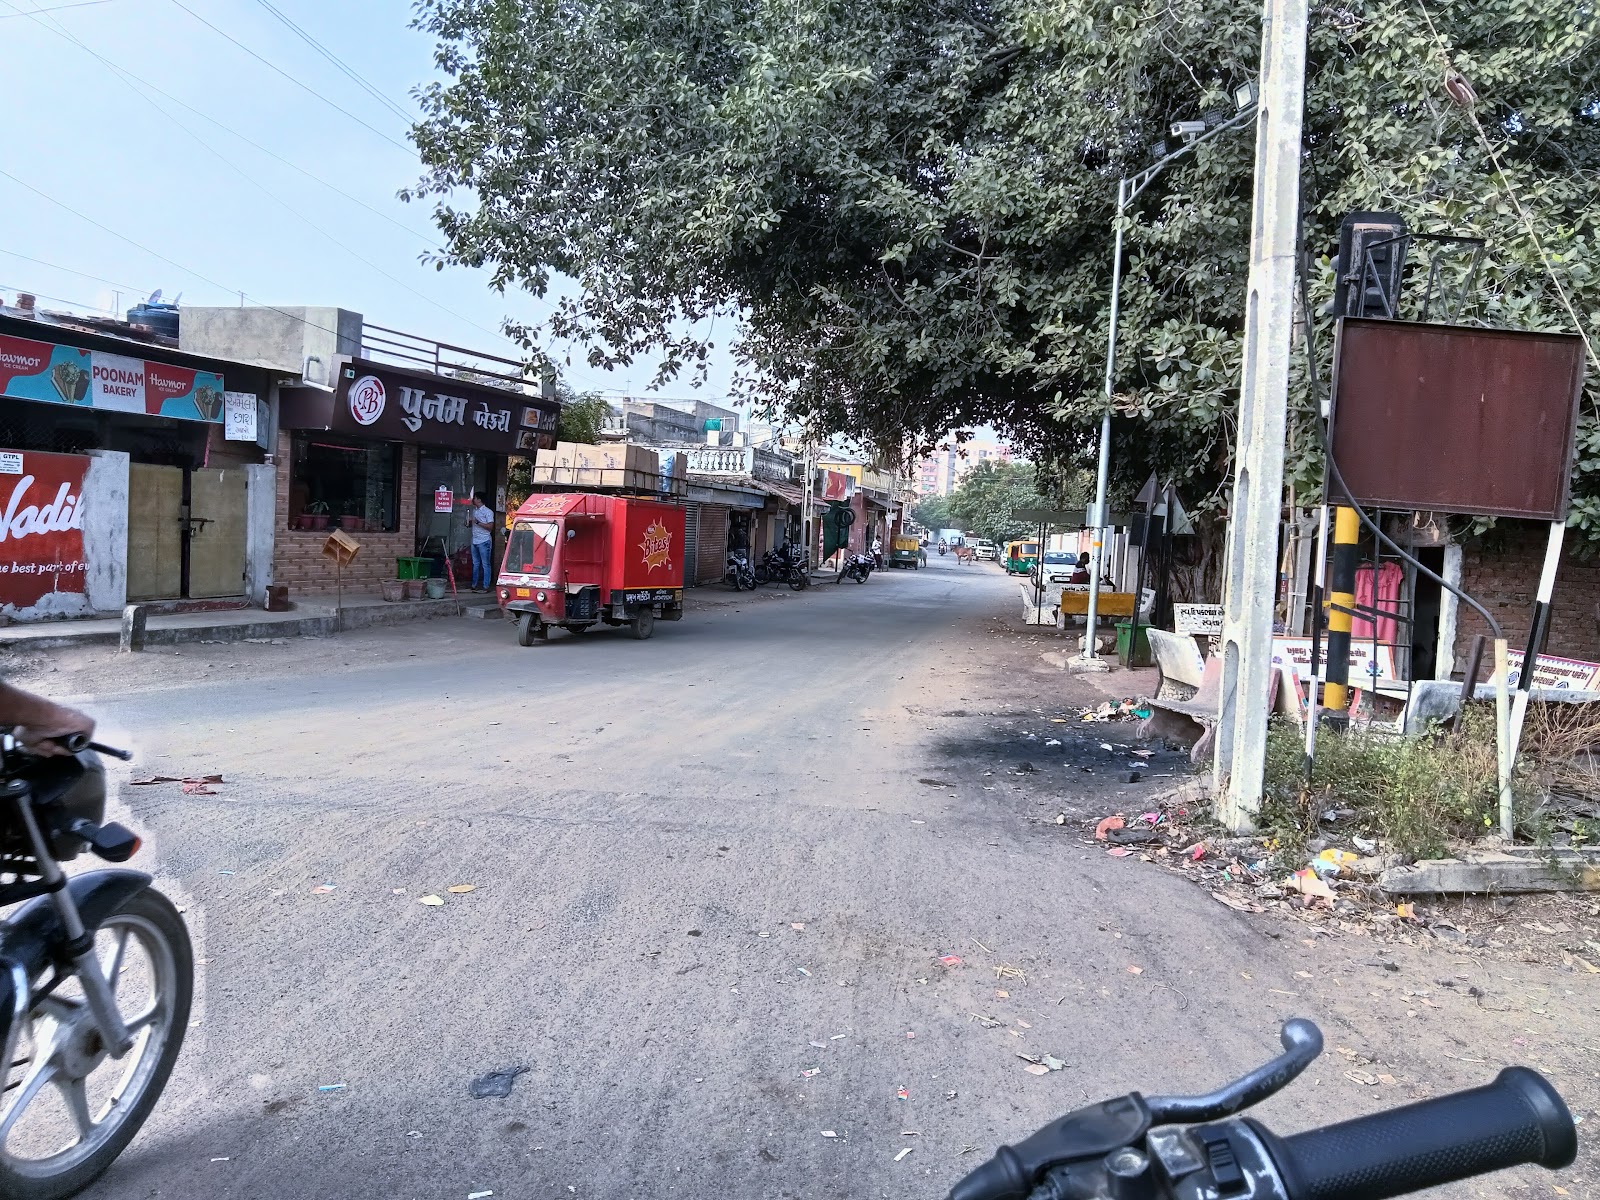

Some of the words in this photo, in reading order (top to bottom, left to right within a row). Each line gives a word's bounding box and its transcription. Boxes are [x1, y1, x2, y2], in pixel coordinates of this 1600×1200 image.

[92, 365, 144, 387] POONAM
[148, 372, 187, 390] Havmor
[103, 383, 137, 398] BAKERY
[399, 386, 469, 433] પુનમ
[473, 402, 511, 433] બેકરી
[644, 535, 671, 560] Bites!
[11, 561, 36, 574] best
[64, 560, 78, 574] of
